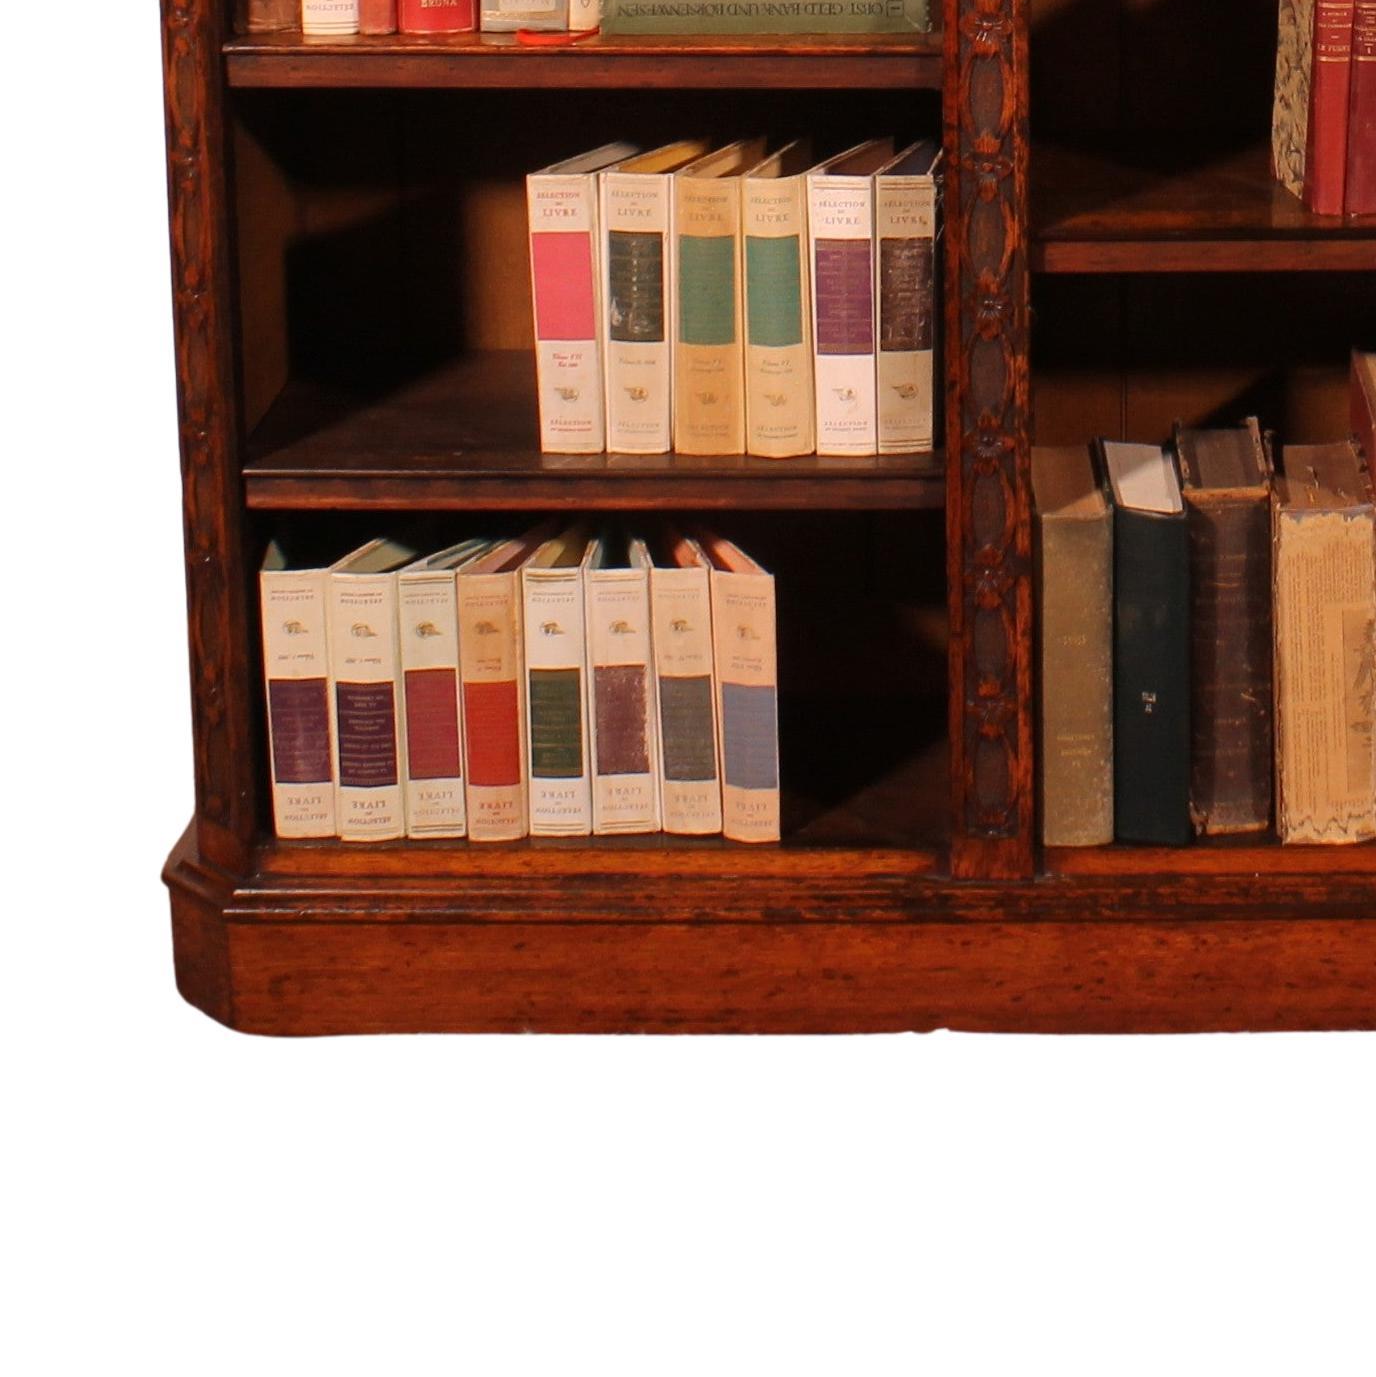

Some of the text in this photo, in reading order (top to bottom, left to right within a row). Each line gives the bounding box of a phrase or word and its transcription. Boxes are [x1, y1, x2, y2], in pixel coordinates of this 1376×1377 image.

[726, 1, 761, 16] UND
[805, 1, 845, 16] GELD
[542, 207, 579, 217] LIVRE
[617, 207, 653, 218] LIVRE
[755, 212, 791, 223] LIVRE
[824, 215, 861, 226] LIVRE
[540, 789, 576, 800] LIVRE
[351, 799, 387, 810] LIVRE
[479, 800, 514, 811] LIVRE
